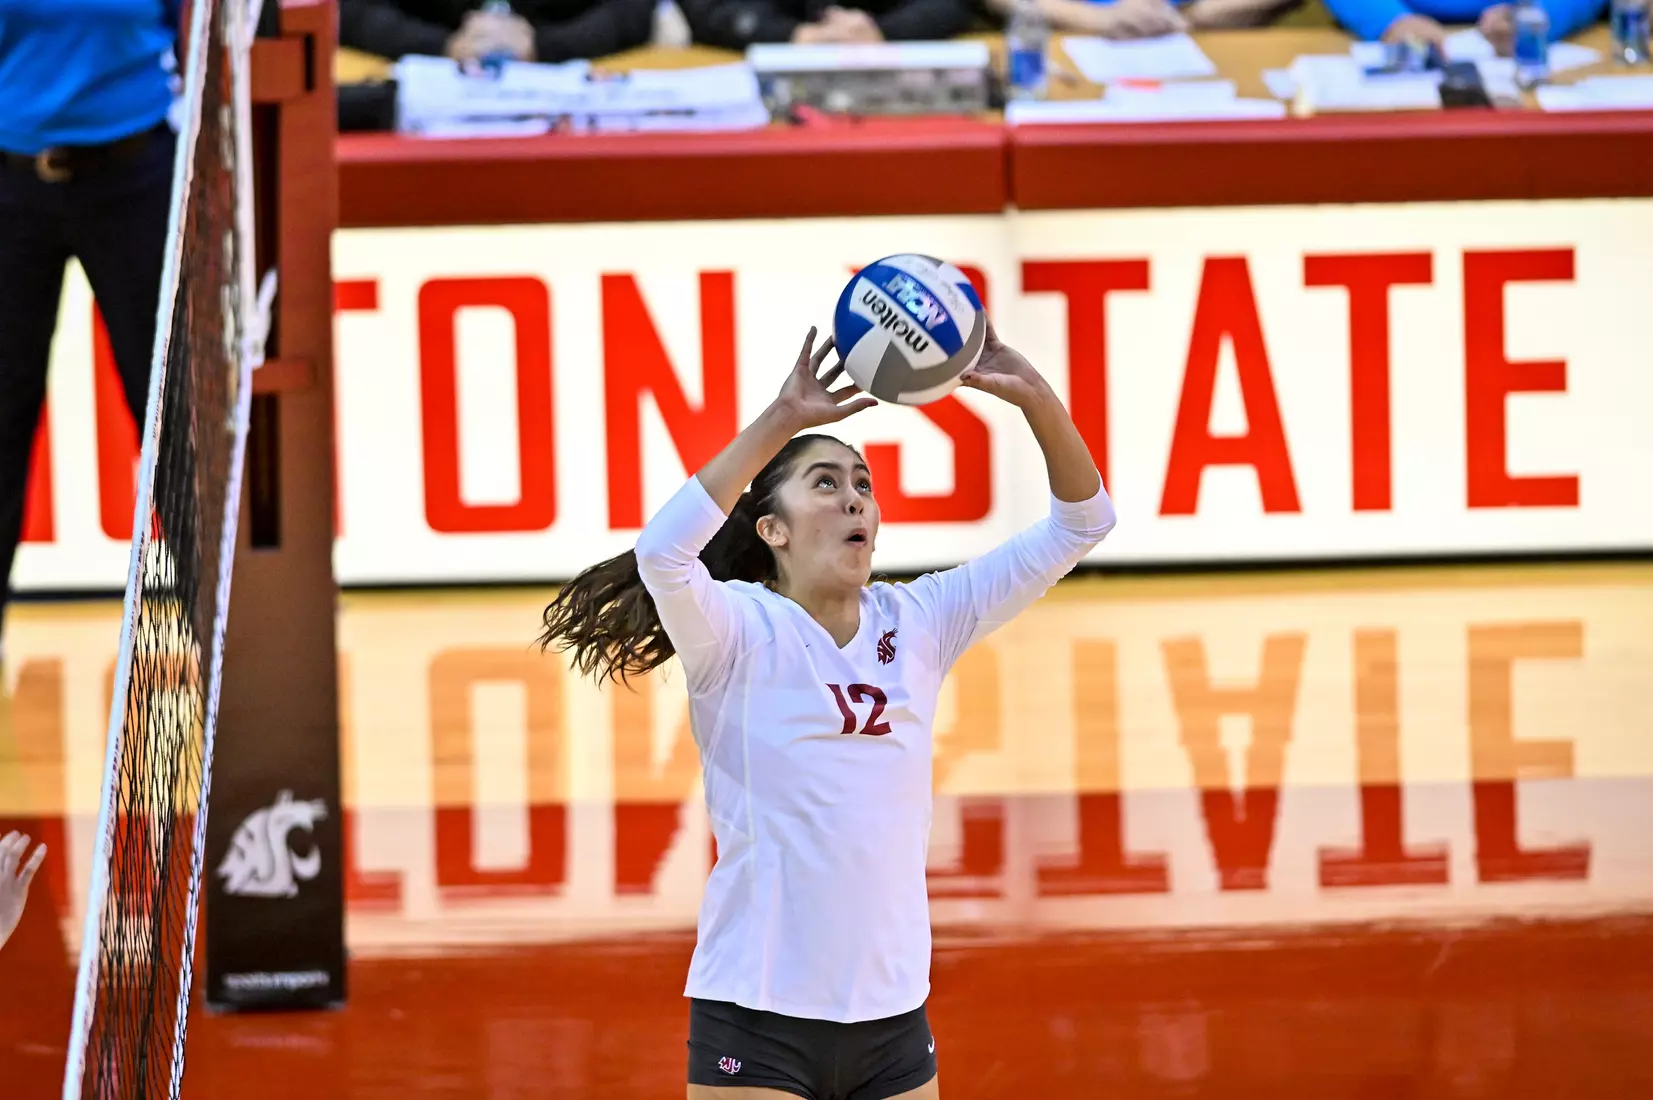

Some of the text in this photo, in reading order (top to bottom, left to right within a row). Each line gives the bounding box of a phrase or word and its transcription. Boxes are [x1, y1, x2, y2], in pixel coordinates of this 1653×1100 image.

[862, 289, 929, 354] molten
[886, 272, 948, 331] NCAA
[824, 682, 893, 736] 12
